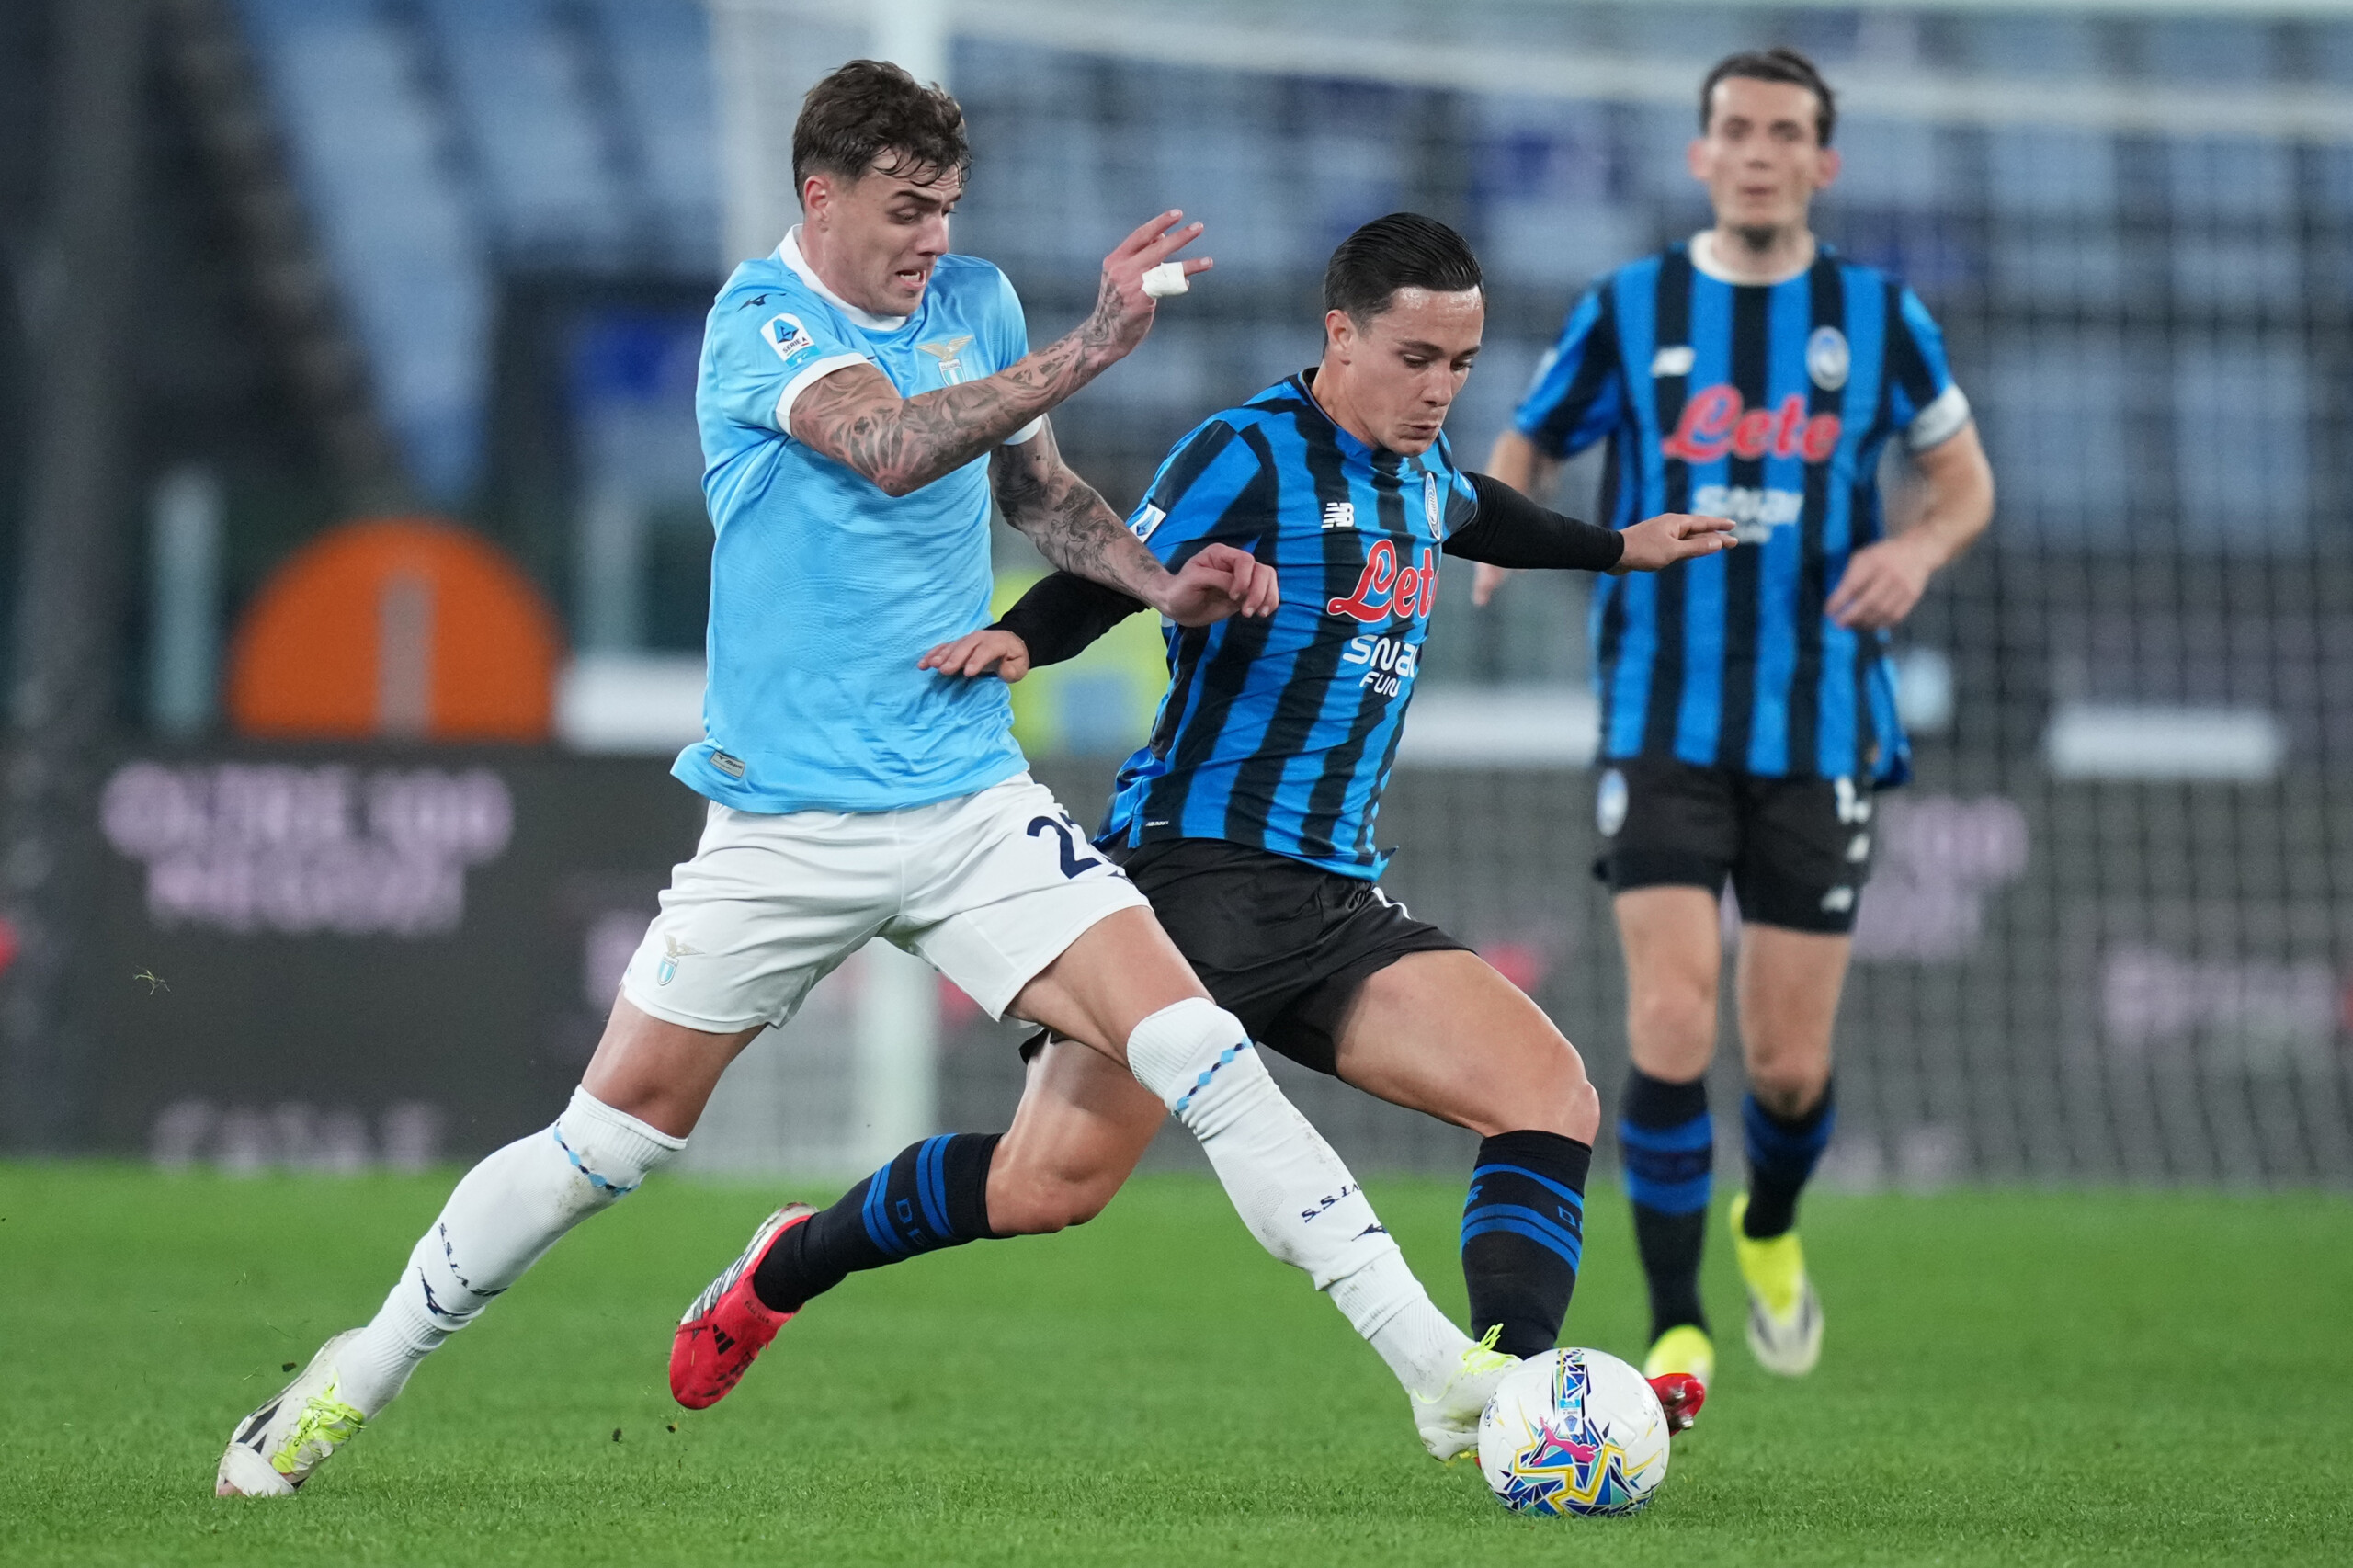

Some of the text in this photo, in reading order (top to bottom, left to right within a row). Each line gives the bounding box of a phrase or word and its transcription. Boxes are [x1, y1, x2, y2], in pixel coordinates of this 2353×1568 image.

[782, 339, 801, 353] SERIE
[1661, 384, 1841, 463] Lete
[1359, 671, 1402, 698] FUN
[1026, 812, 1123, 880] 2
